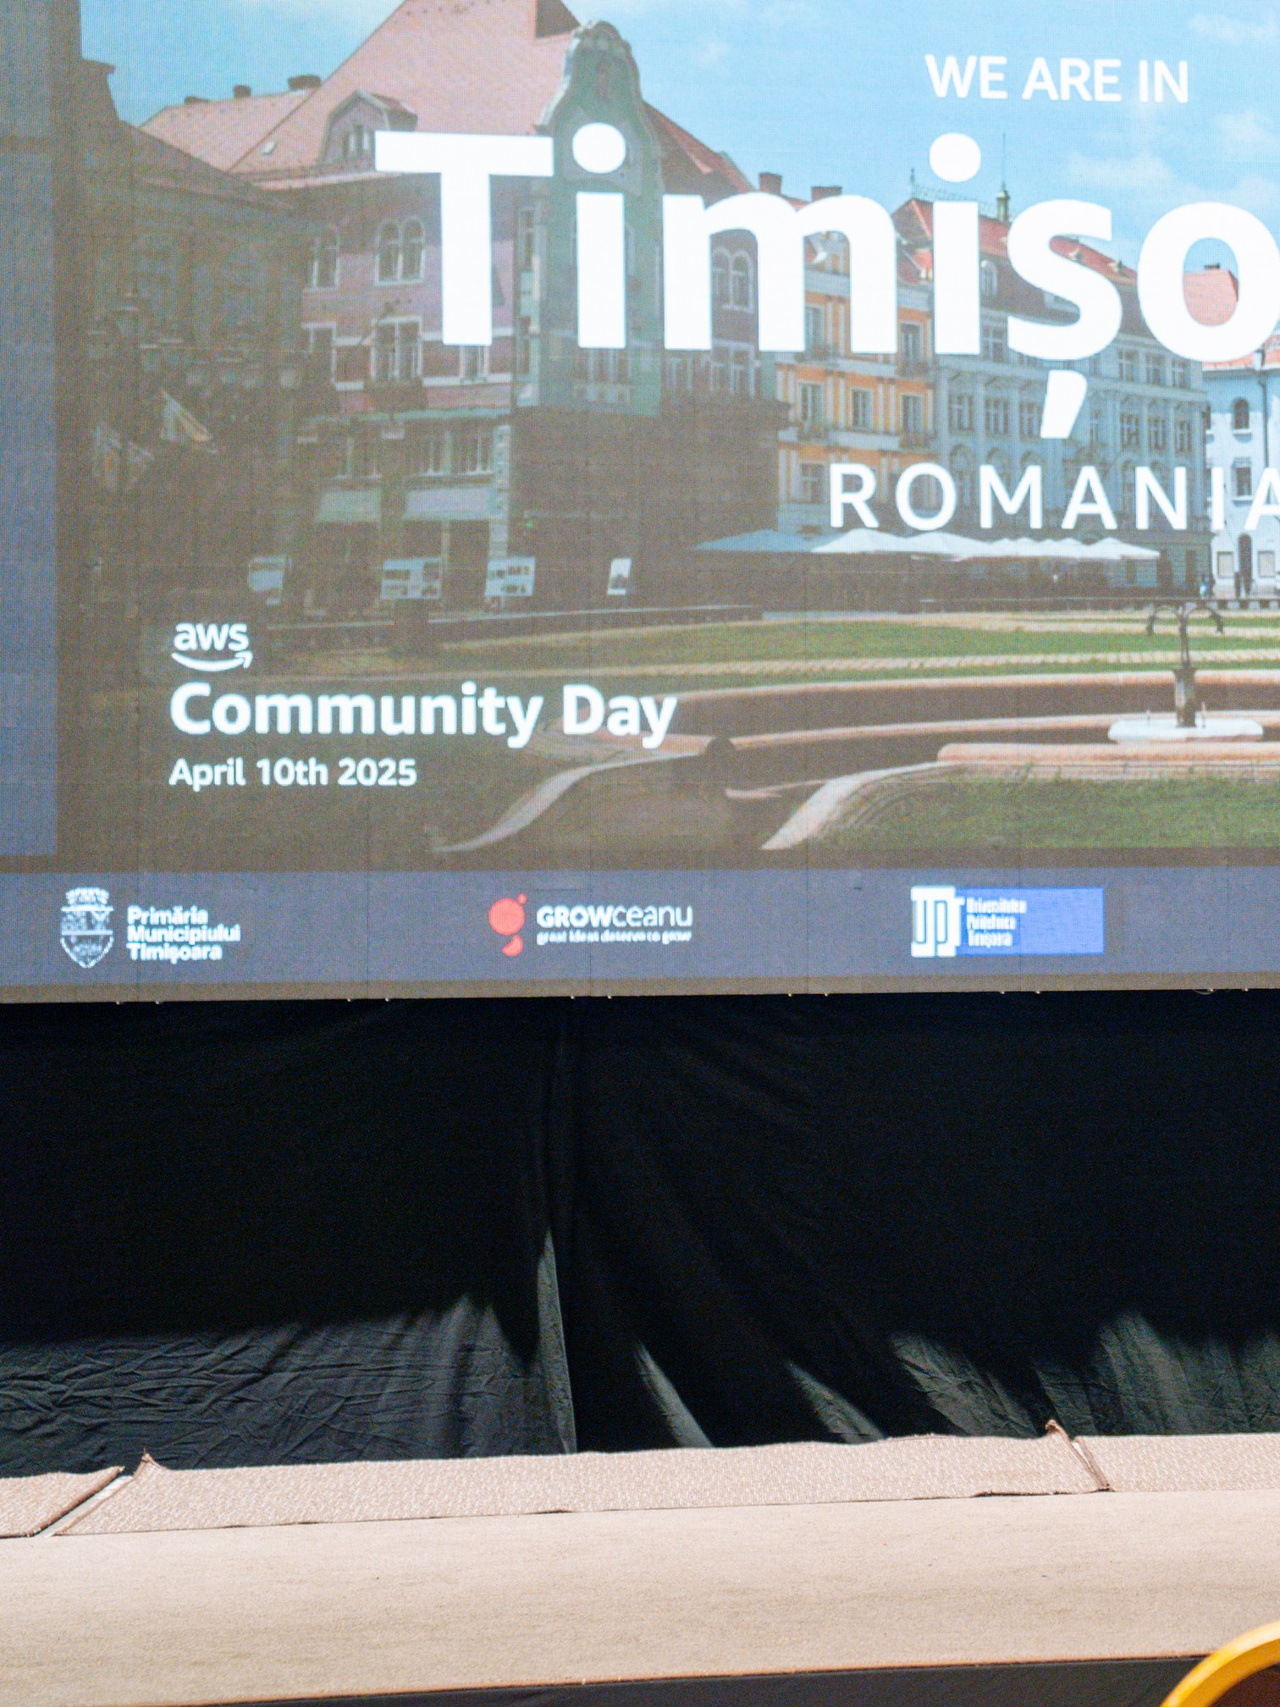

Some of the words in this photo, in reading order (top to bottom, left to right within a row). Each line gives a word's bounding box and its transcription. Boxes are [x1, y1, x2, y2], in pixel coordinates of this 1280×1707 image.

[925, 54, 1008, 100] WE
[1021, 56, 1122, 102] ARE
[1139, 59, 1189, 103] IN
[172, 622, 251, 653] aws
[169, 681, 545, 749] Community
[562, 685, 678, 749] Day
[169, 757, 246, 792] April
[256, 758, 328, 786] 10th
[337, 759, 417, 786] 2025
[536, 905, 693, 928] GROWceanu
[127, 924, 241, 945] Municipiului
